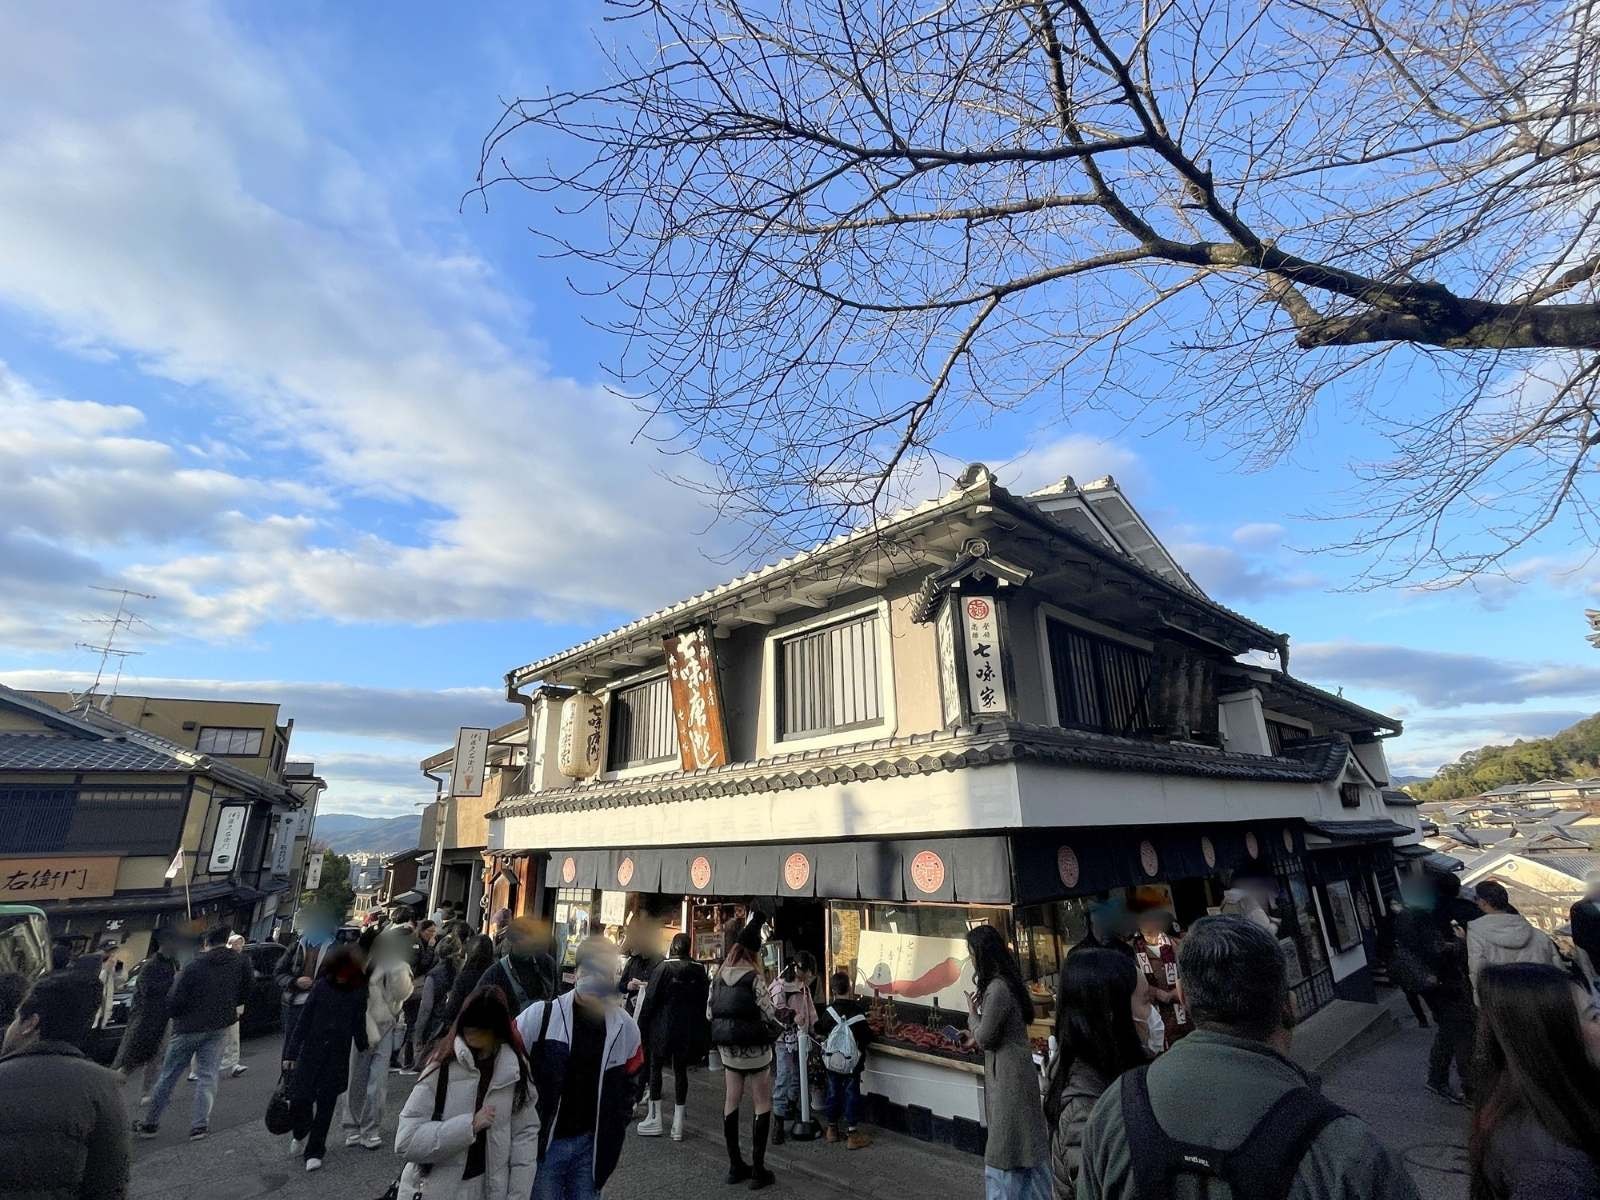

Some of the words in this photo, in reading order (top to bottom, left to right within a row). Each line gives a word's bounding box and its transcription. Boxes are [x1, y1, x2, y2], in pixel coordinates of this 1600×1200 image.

[973, 642, 997, 709] 七味家
[2, 867, 88, 891] 右衛門
